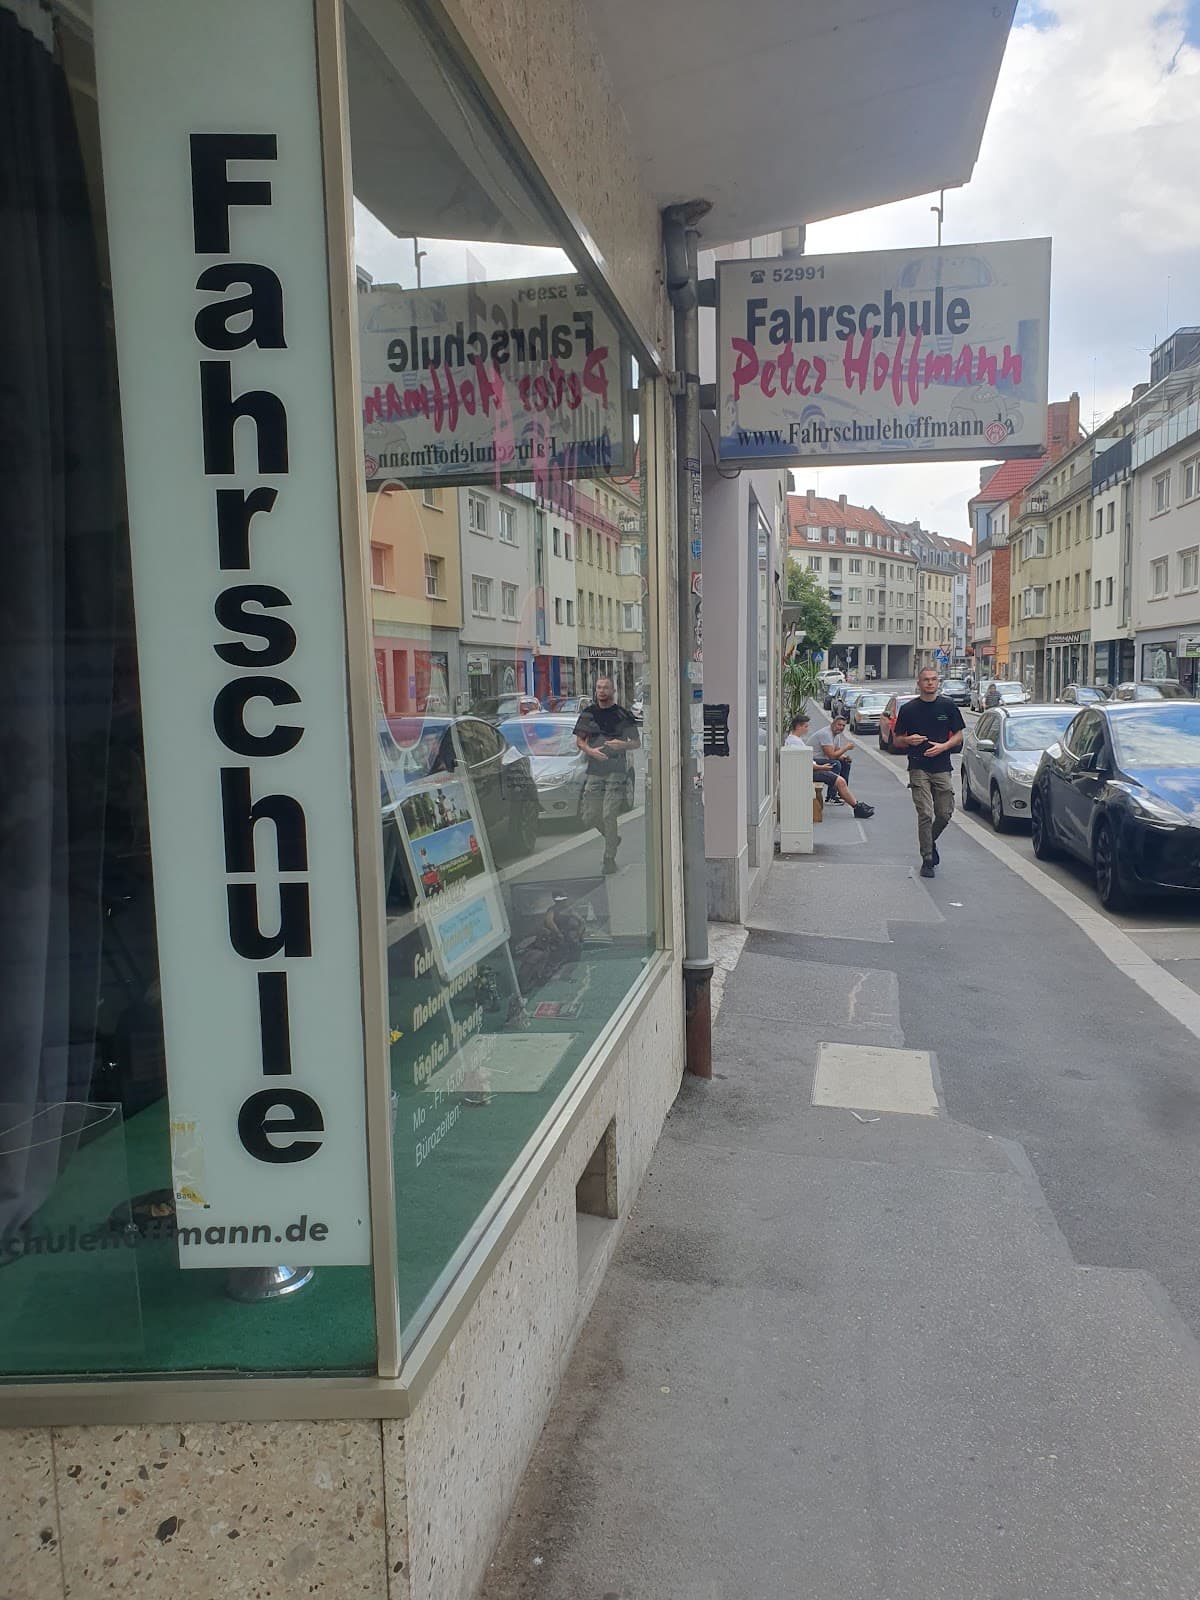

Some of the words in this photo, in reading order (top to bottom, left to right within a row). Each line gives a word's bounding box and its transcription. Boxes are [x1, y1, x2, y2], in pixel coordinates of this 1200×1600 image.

[772, 265, 825, 282] 52991
[746, 286, 971, 346] Fahrschule
[731, 337, 828, 401] Peter
[843, 327, 1023, 407] Hoffmann
[188, 132, 326, 1165] Fahrschule
[412, 1035, 450, 1086] täglich
[414, 1102, 463, 1168] Bürozeiten:
